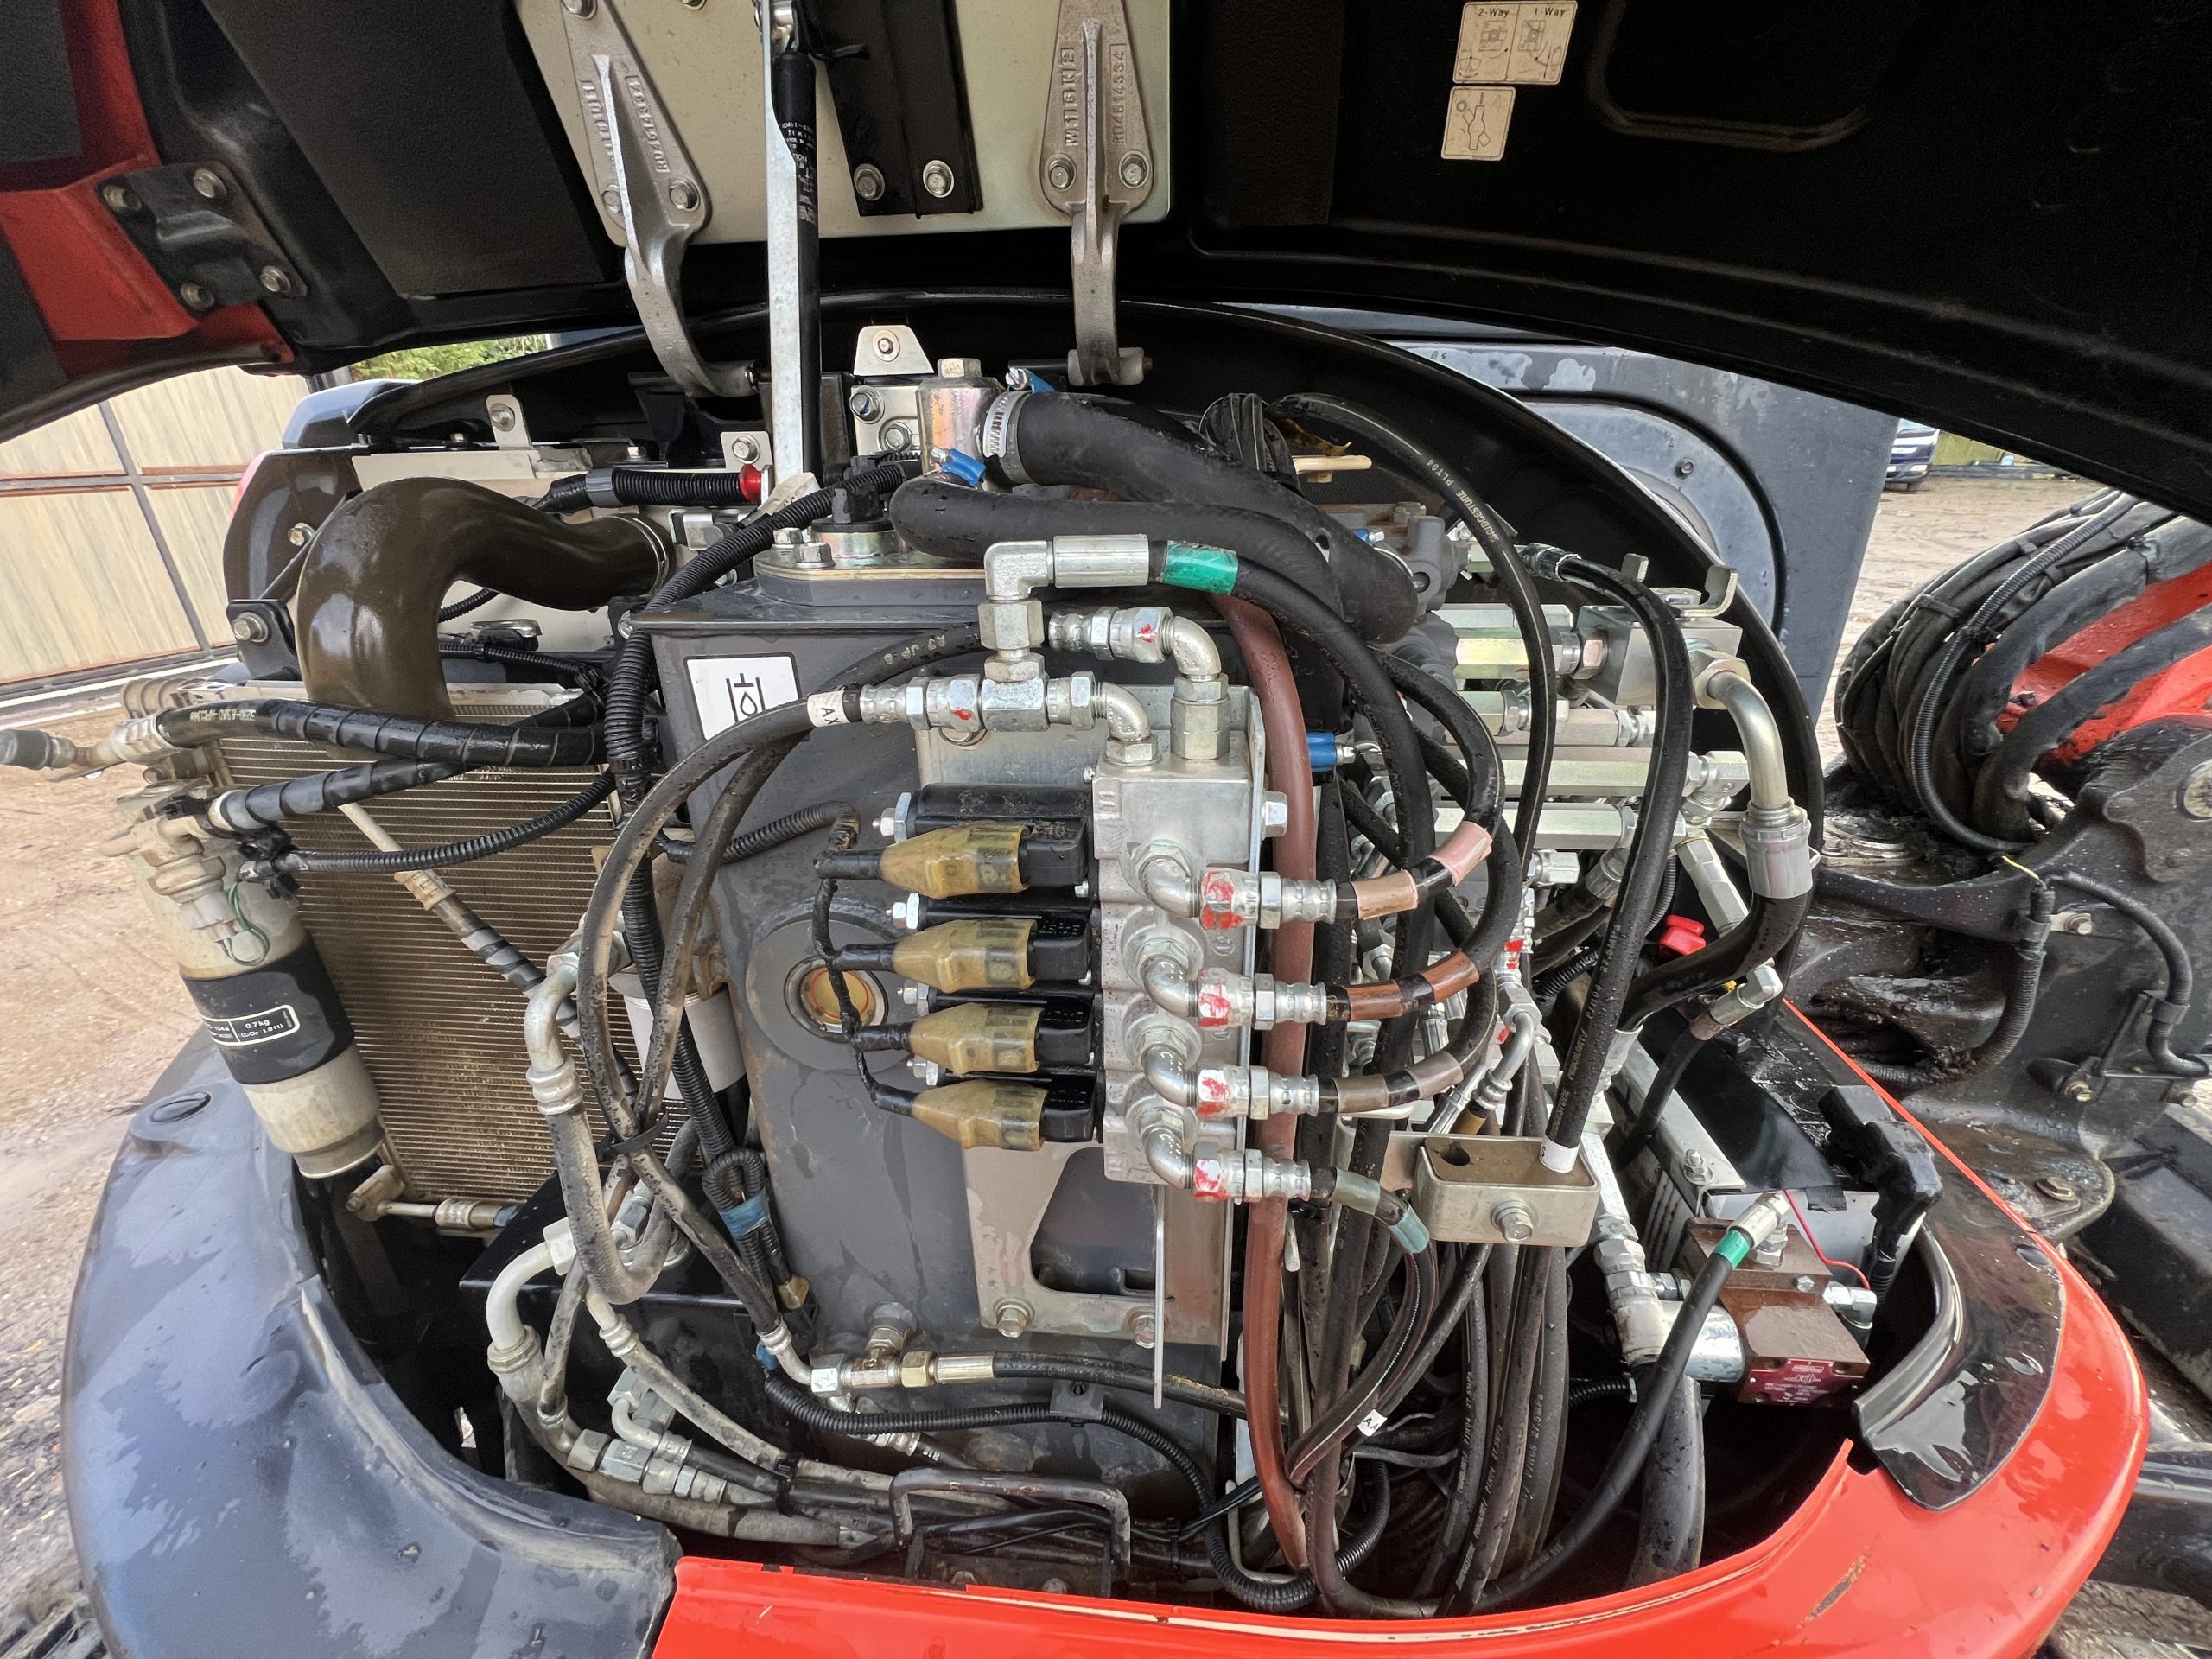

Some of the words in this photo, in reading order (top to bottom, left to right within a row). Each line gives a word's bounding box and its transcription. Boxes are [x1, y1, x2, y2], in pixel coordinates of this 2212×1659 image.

[1478, 9, 1510, 17] 2-Way
[1534, 8, 1566, 16] 1-Way
[1427, 459, 1455, 486] PLT04
[821, 707, 841, 725] AX
[245, 1020, 270, 1029] 0.7kg
